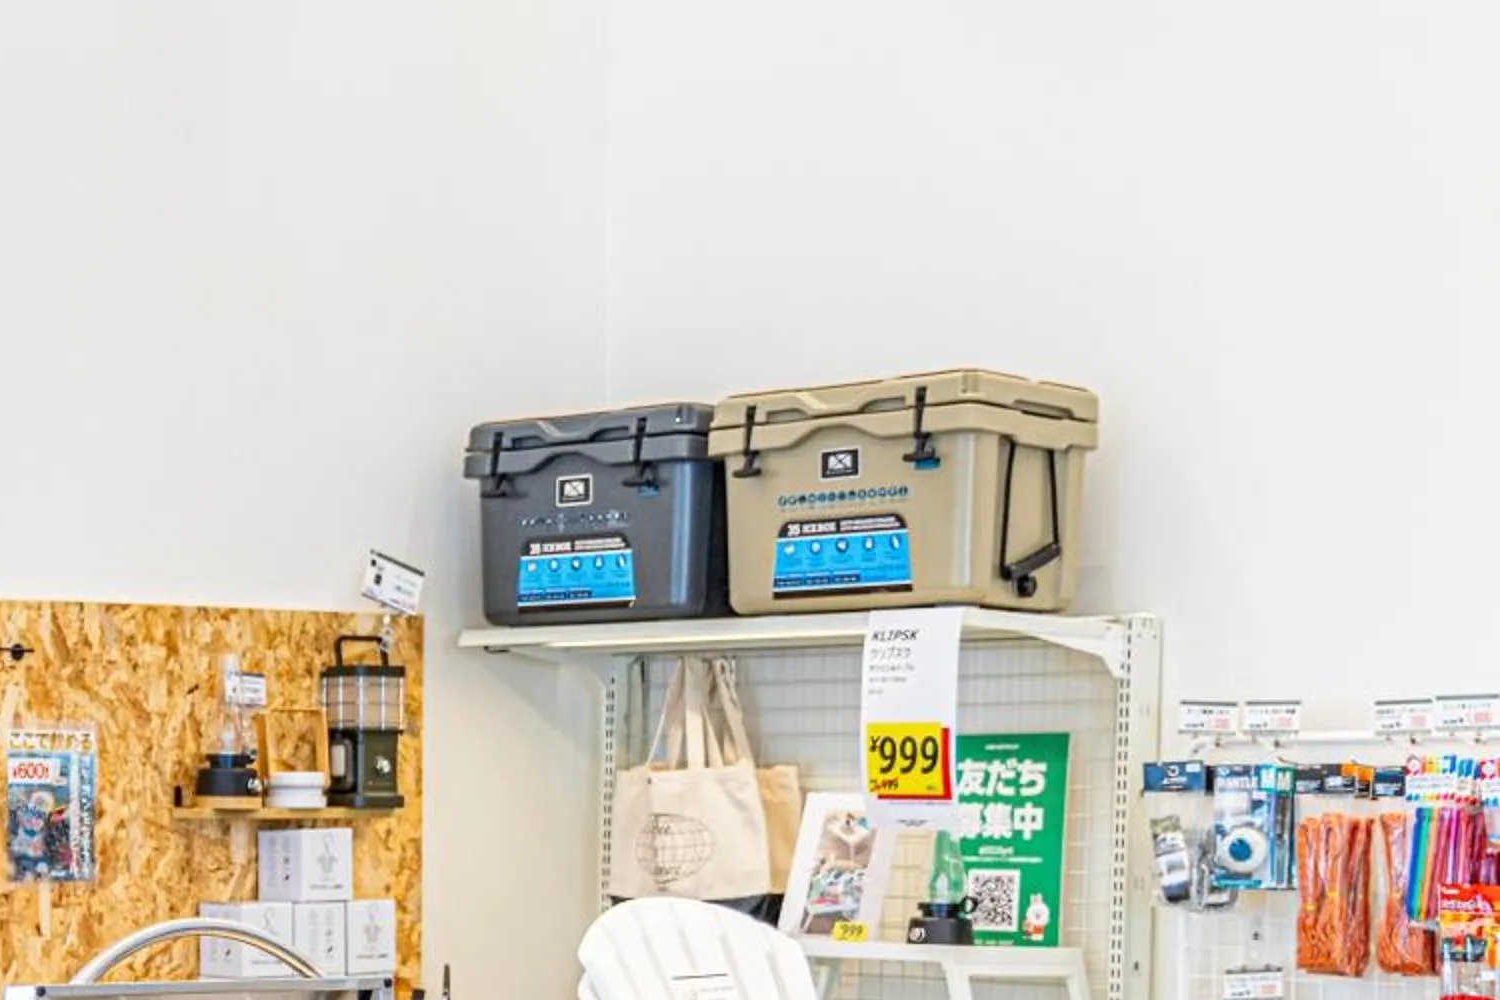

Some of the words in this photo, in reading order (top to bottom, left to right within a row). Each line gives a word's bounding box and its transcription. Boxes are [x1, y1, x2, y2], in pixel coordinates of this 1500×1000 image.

[872, 629, 919, 641] KLIPSK
[870, 736, 939, 774] ¥999
[958, 758, 1047, 797] 友だち
